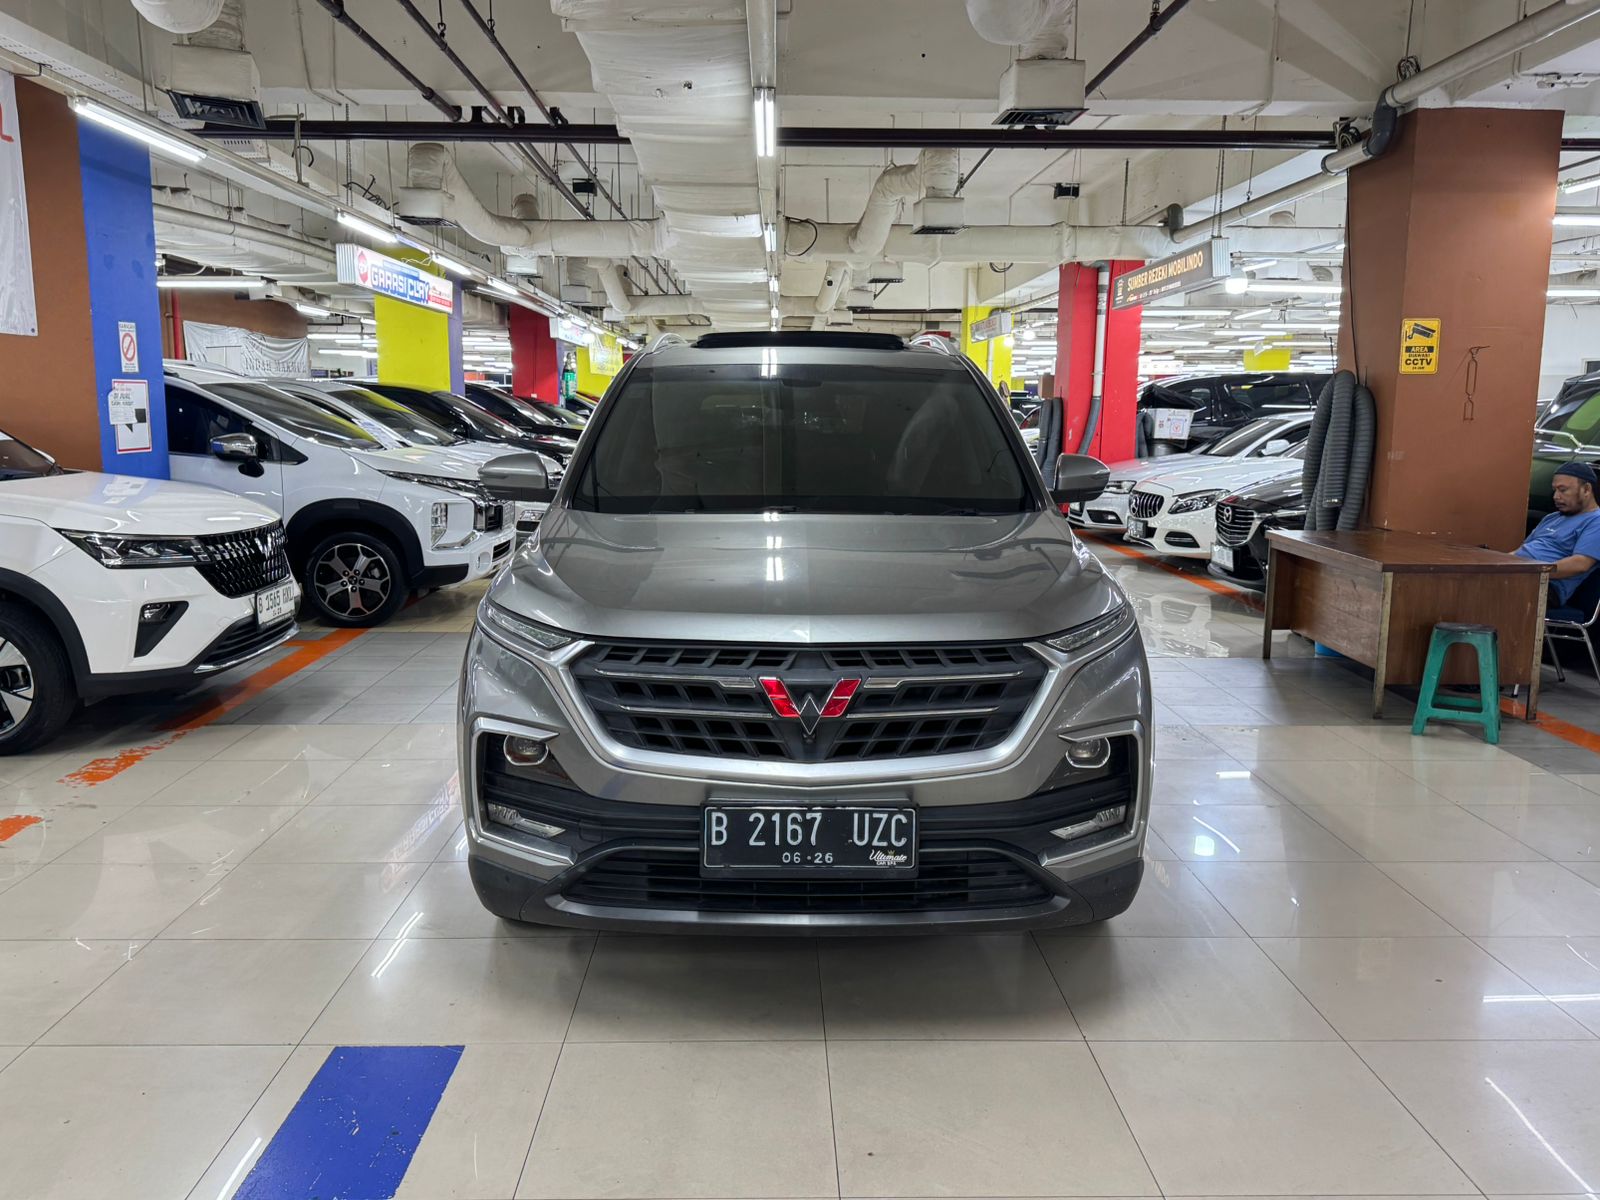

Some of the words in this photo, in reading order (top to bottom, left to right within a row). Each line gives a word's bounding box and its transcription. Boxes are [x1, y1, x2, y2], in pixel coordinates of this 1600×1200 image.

[371, 264, 407, 295] GARASI
[1127, 271, 1148, 292] SUMBER
[1148, 265, 1168, 284] REZEKI
[1168, 250, 1204, 277] MOBILINDO
[710, 812, 728, 846] B
[748, 812, 822, 846] 2167
[853, 812, 908, 847] UZC
